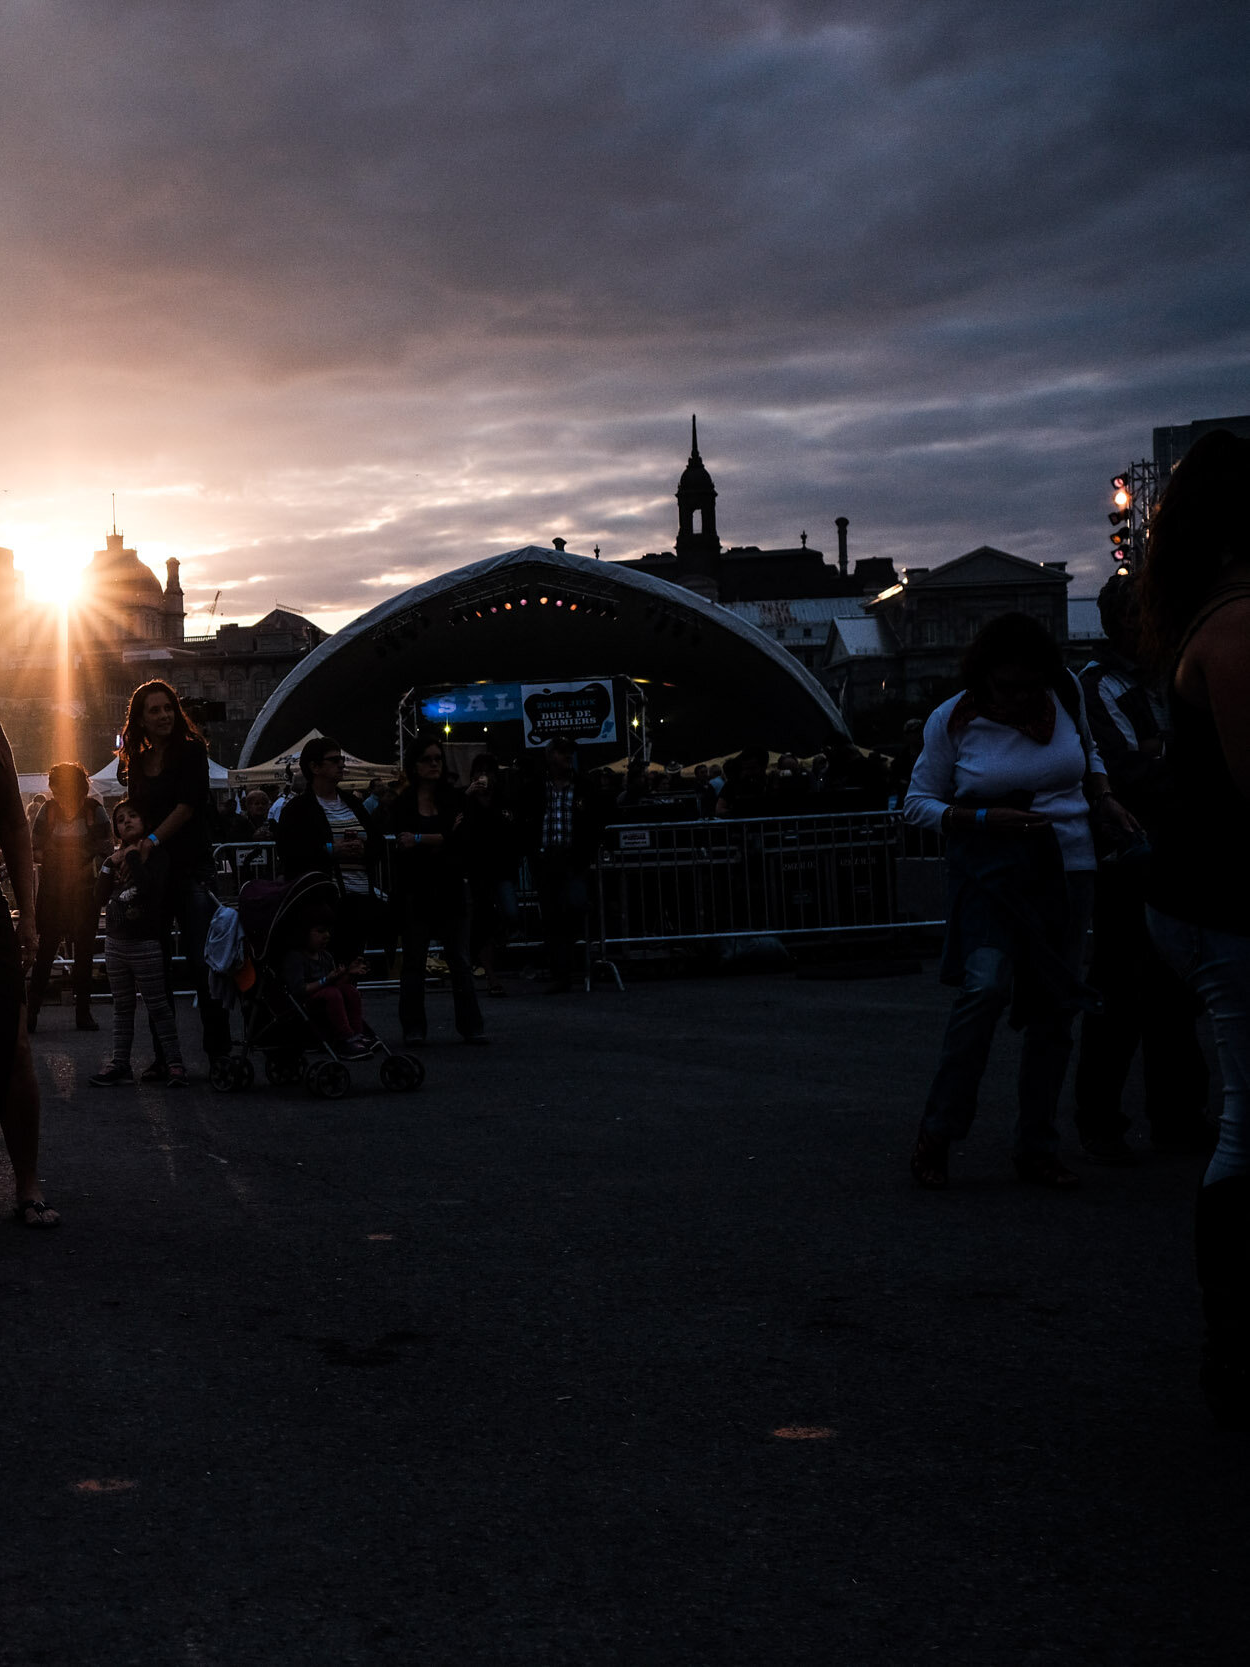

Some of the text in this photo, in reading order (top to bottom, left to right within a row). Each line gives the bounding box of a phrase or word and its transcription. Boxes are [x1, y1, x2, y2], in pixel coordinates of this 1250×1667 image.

[541, 709, 592, 720] DUEL DE
[536, 717, 596, 727] FERMIERS
